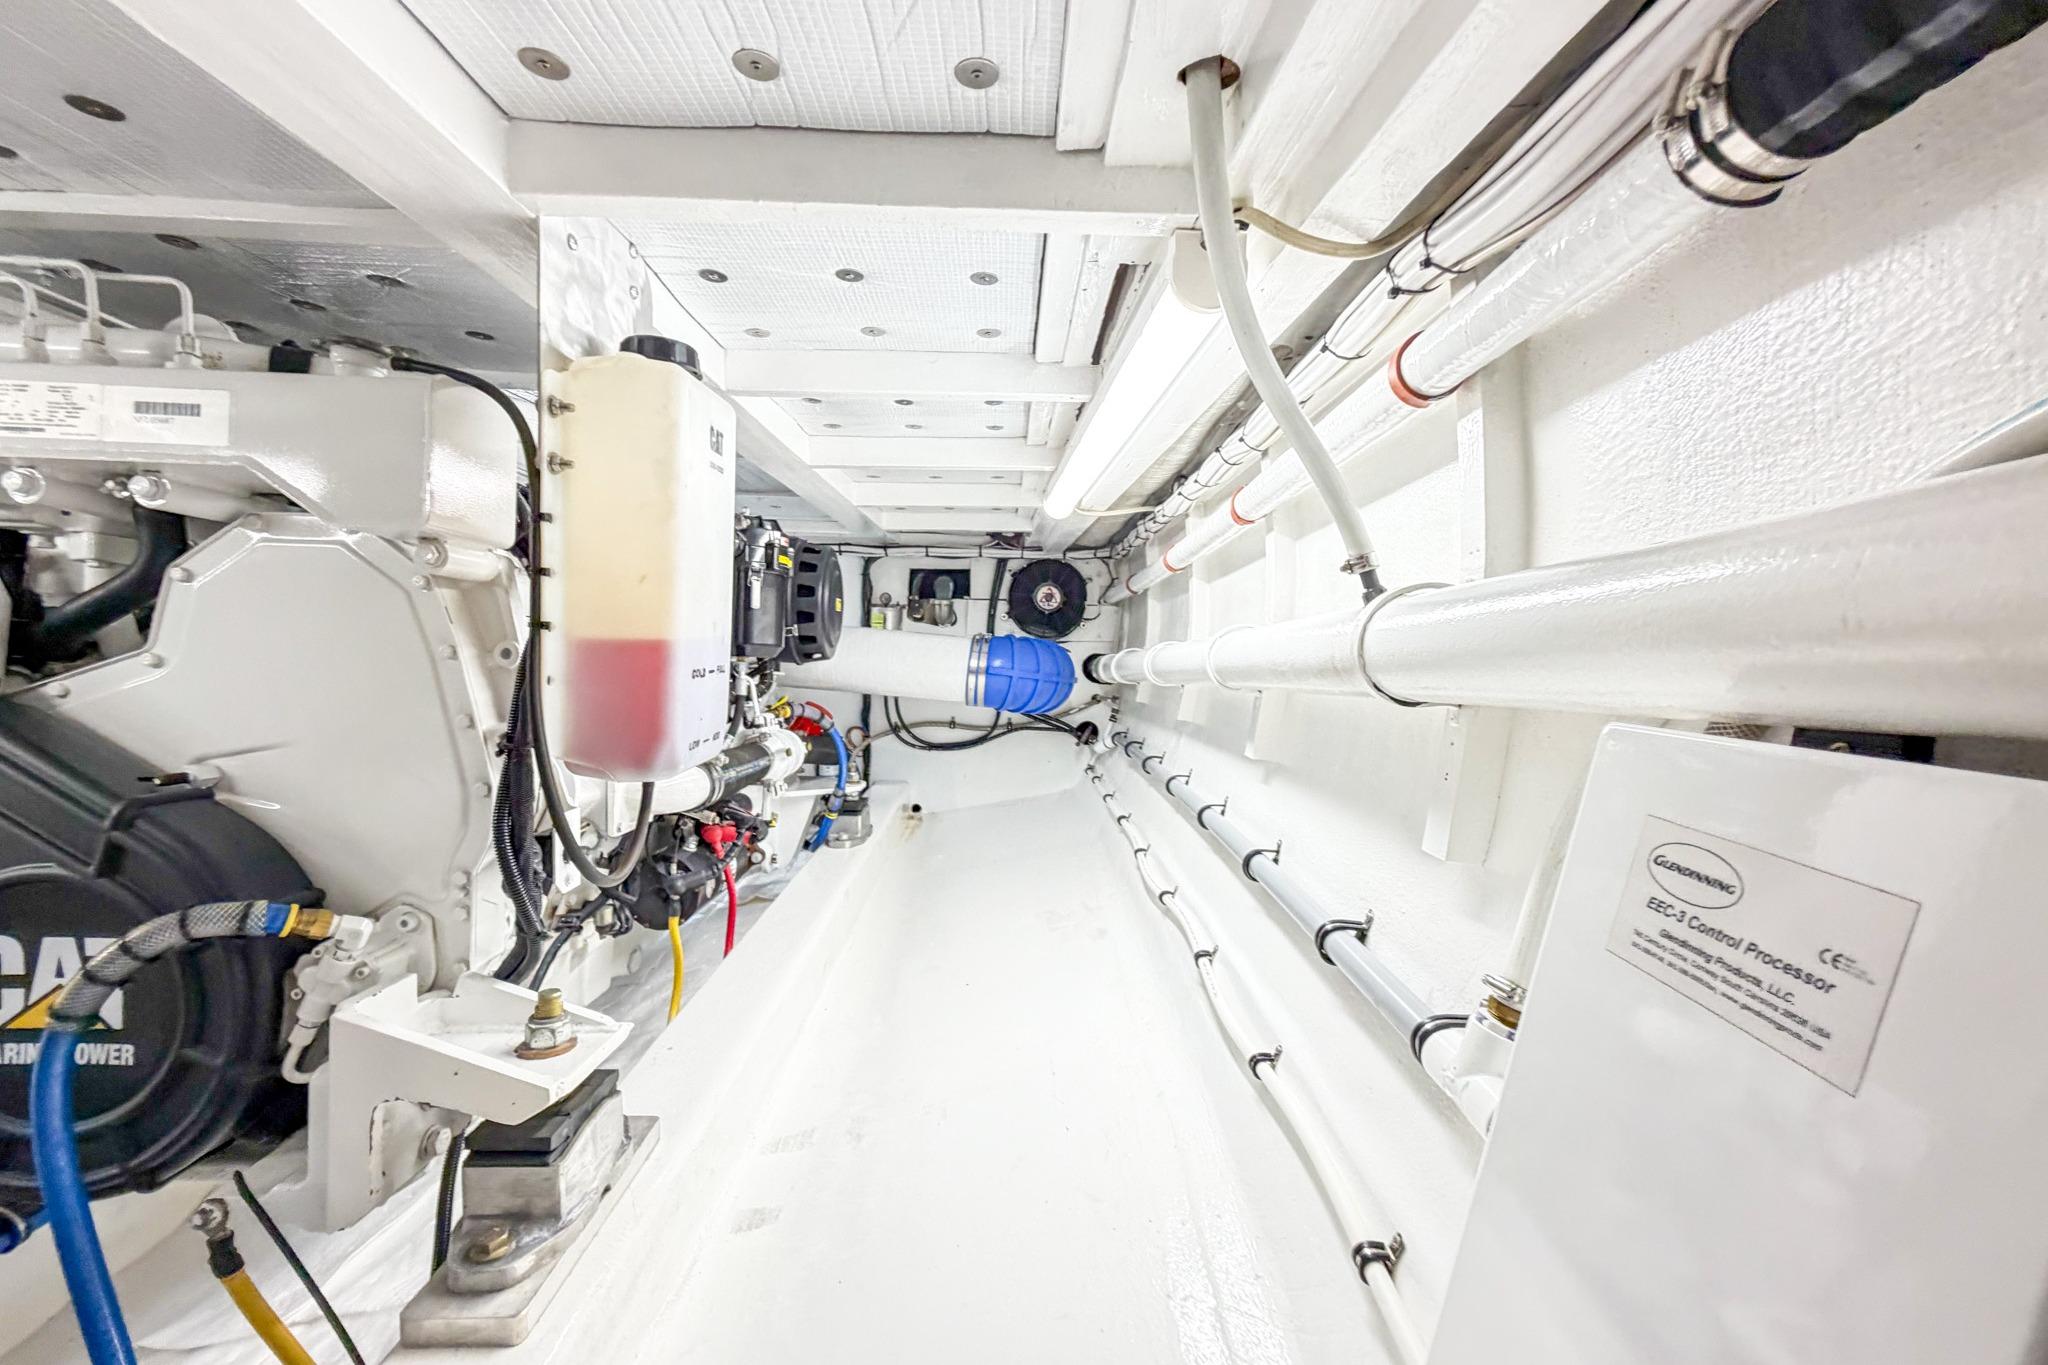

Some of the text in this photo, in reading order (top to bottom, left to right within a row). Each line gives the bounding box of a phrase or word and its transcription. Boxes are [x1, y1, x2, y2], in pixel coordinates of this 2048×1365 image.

[1653, 854, 1737, 895] GLENDINNING
[1646, 896, 1687, 923] EEC-3
[1687, 915, 1744, 950] Control
[1743, 941, 1837, 994] Processor
[74, 1042, 135, 1066] OWER
